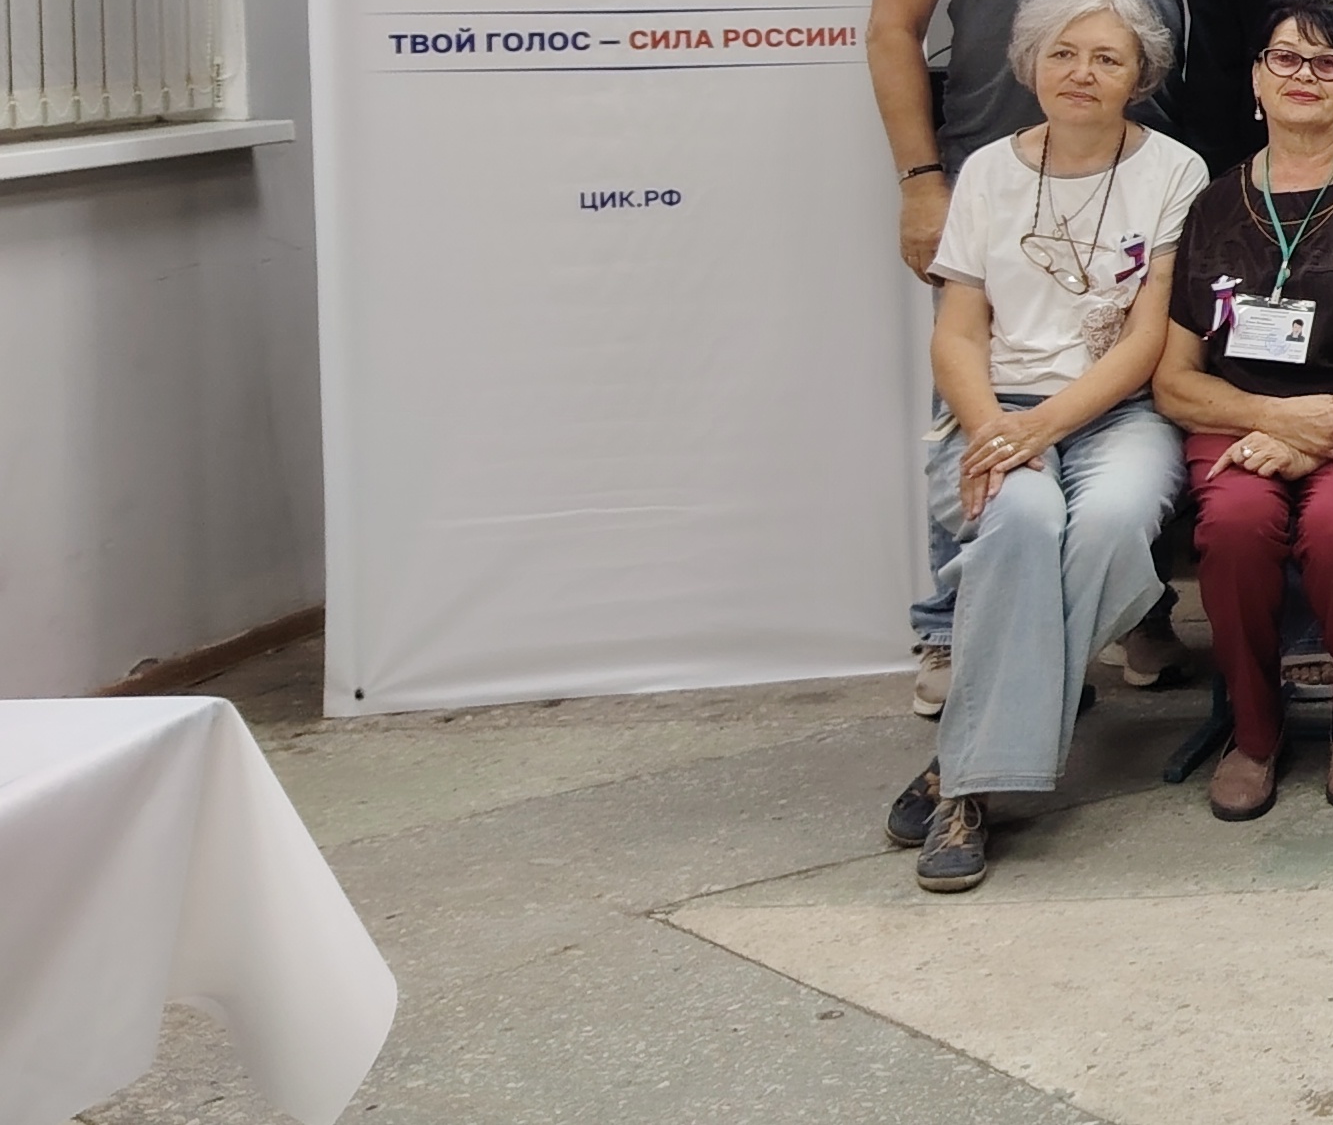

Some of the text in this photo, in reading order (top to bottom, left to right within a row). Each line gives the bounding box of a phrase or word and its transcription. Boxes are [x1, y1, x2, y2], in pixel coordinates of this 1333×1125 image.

[389, 28, 475, 53] ТВОЙ
[486, 32, 591, 52] ГОЛОС
[628, 29, 714, 50] СИЛА
[723, 27, 858, 48] РОССИИ!
[580, 189, 682, 212] ЦИК.РФ
